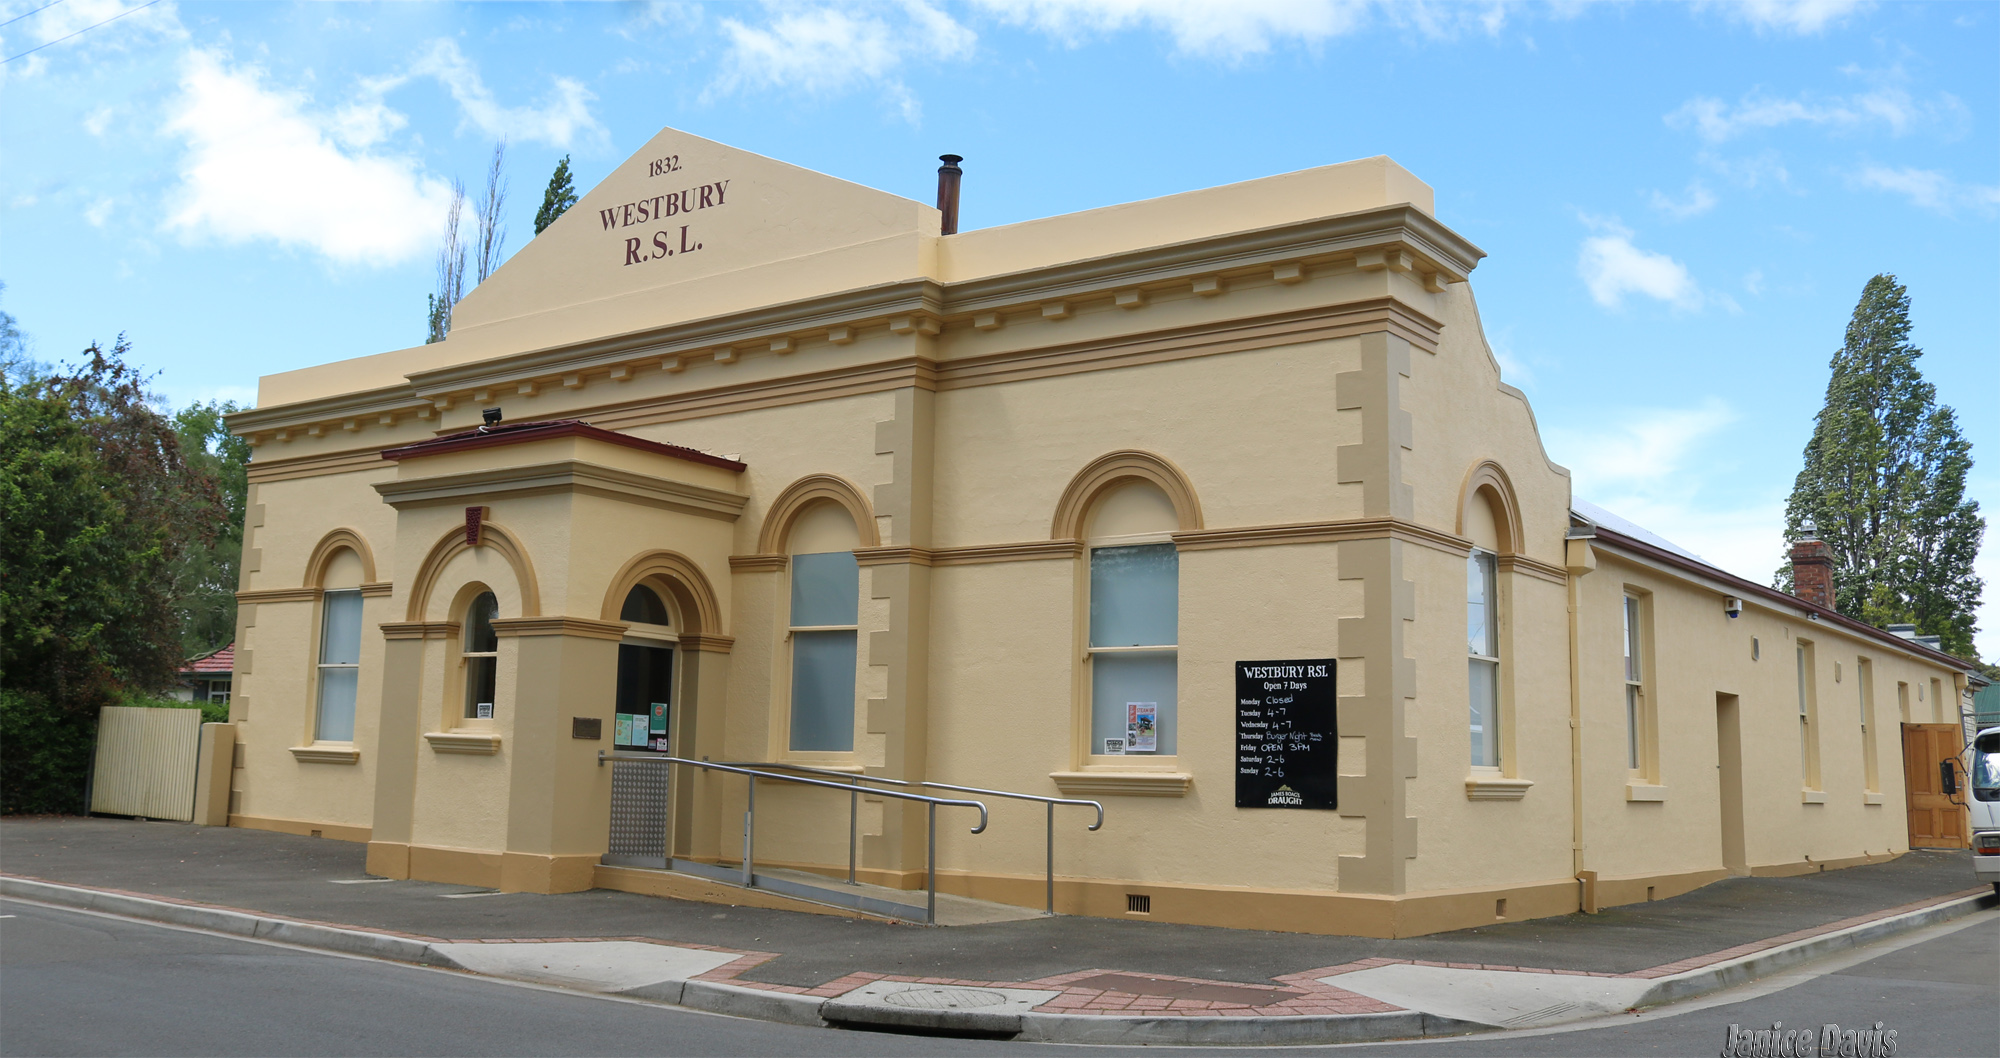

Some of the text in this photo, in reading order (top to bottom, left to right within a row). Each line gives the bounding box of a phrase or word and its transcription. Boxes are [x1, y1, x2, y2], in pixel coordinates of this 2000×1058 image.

[648, 154, 682, 178] 1832.
[599, 179, 730, 231] WESTBURY
[1243, 665, 1328, 678] WESTBURY RSL
[1263, 681, 1307, 691] Open 7 Days
[1240, 698, 1260, 706] Monday
[1265, 694, 1293, 705] Closed
[1240, 710, 1261, 718] Tuesday
[1267, 708, 1286, 717] 4-7
[1240, 721, 1269, 729] Wednesday
[1272, 720, 1292, 730] 4-7
[1240, 732, 1263, 741] Thursday
[1266, 731, 1288, 743] Burger
[1289, 731, 1307, 742] Night
[1240, 744, 1257, 752] Friday
[1261, 743, 1310, 752] OPEN 3PM
[1240, 755, 1263, 764] Saturday
[1266, 754, 1285, 764] 2-6
[1240, 767, 1259, 775] Sunday
[1264, 767, 1285, 778] 2-6
[1267, 797, 1303, 805] DRAUGHT
